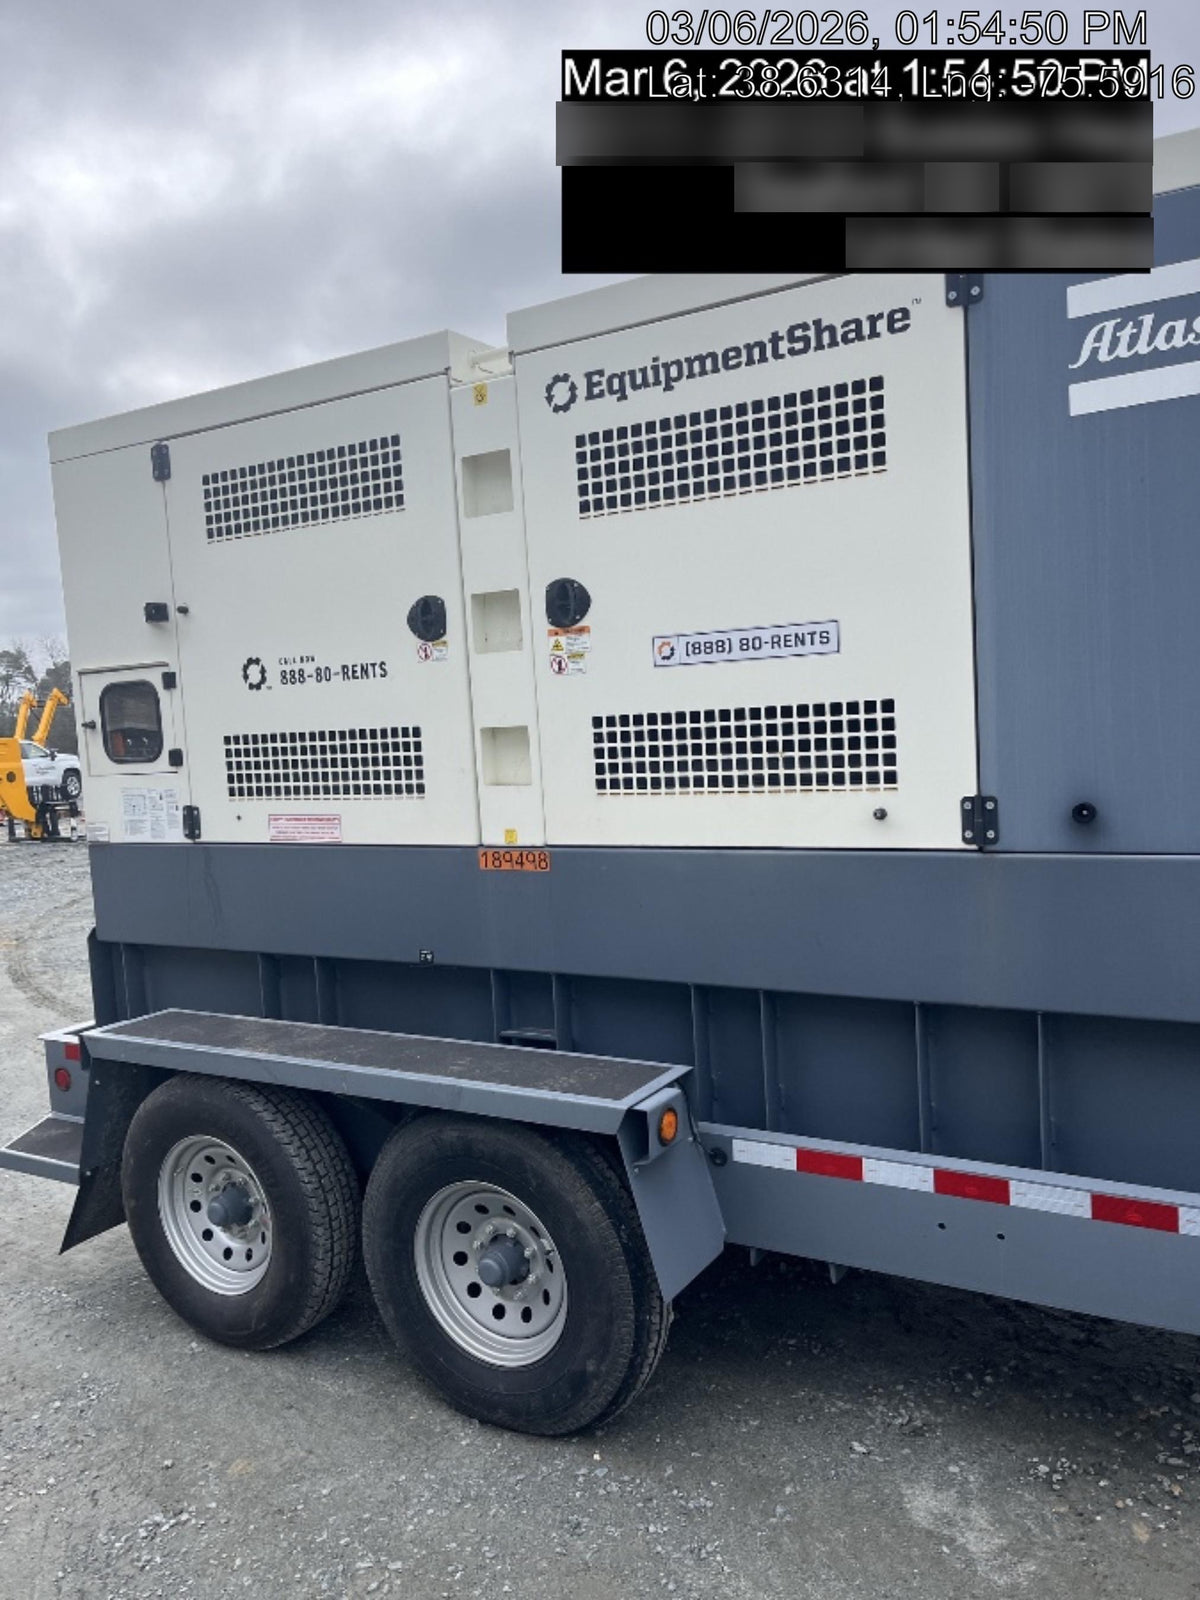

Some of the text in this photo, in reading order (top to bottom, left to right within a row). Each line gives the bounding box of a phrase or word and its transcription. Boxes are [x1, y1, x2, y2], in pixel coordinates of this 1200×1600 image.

[583, 305, 912, 402] EquipmentShare
[684, 629, 831, 658] (888) 80-RENTS
[279, 660, 388, 686] 888-80-RENTS
[480, 850, 549, 871] 189498
